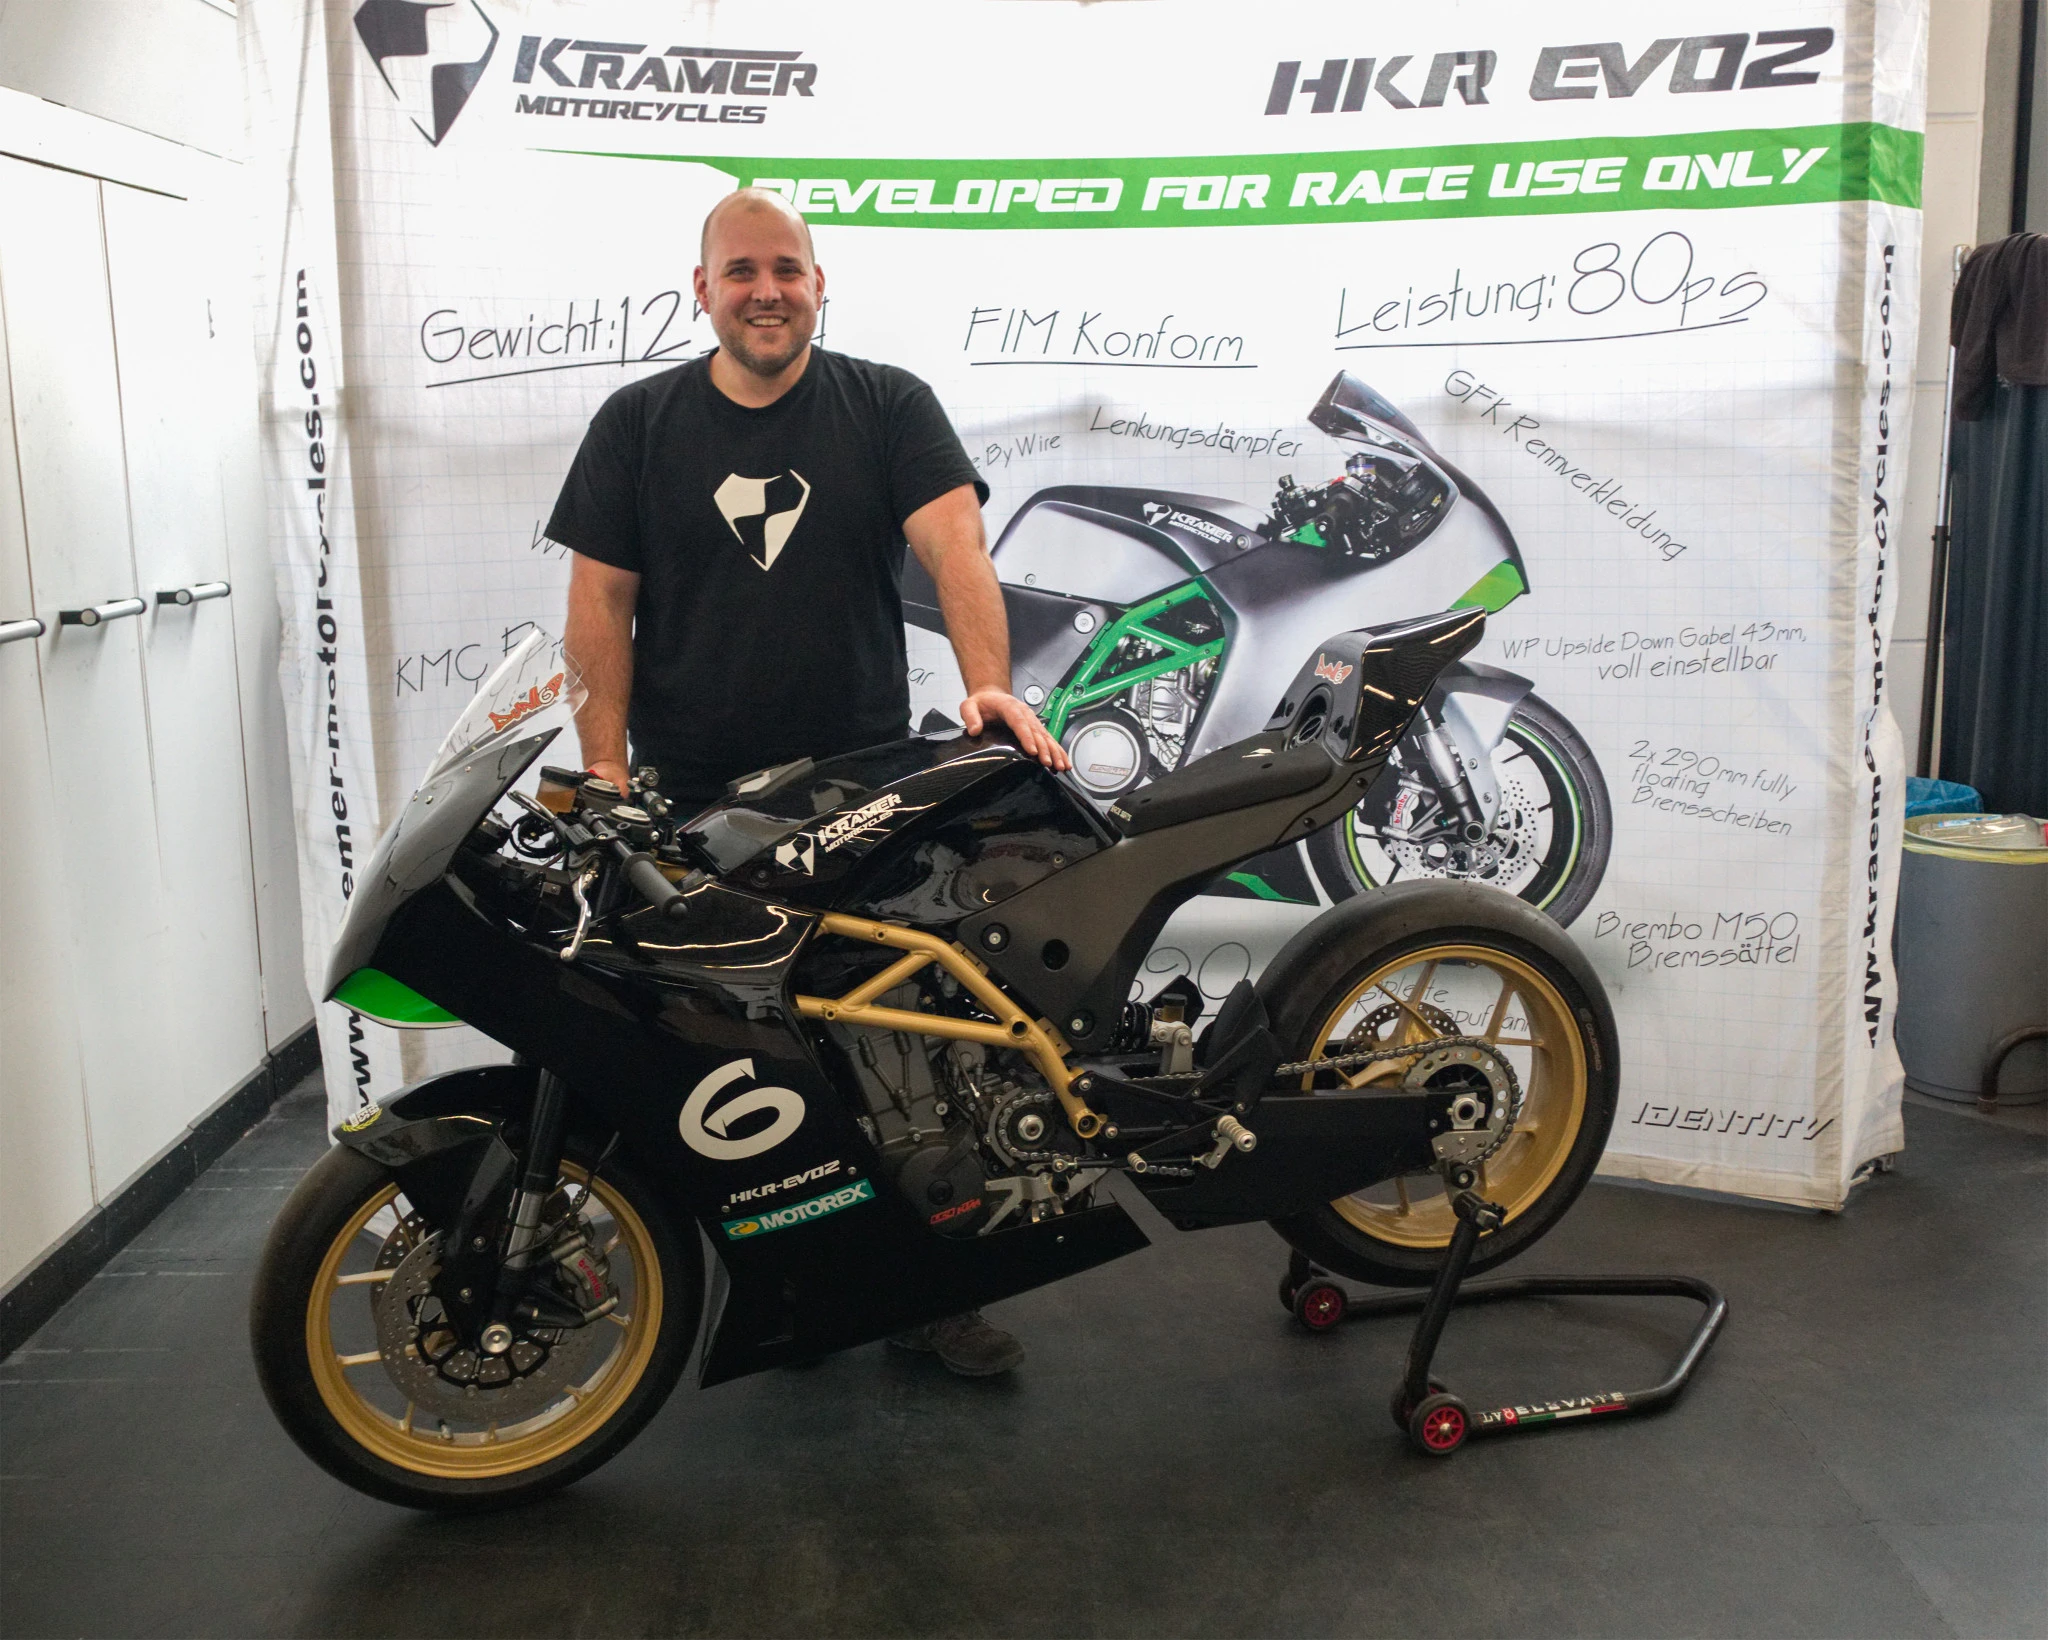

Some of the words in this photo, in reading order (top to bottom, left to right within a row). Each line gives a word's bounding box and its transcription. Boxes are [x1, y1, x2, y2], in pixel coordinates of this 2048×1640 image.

[1264, 50, 1497, 115] HKR
[515, 95, 767, 124] MOTORCYCLES
[1141, 174, 1268, 211] FOR
[1288, 165, 1474, 206] RACE
[1490, 157, 1628, 196] USE
[1641, 147, 1830, 192] ONLY
[964, 307, 1060, 354] FIM
[1073, 311, 1243, 361] Konform
[986, 444, 1013, 468] By
[1016, 433, 1061, 457] Wire
[1090, 406, 1303, 459] Lenkungsdämpfer
[1445, 370, 1511, 426] GFK
[1503, 414, 1687, 562] Rennverkleidung
[1168, 520, 1221, 544] MOTORCYCLES
[1503, 637, 1540, 660] WP
[1545, 634, 1616, 660] Upside
[1621, 631, 1674, 652] Down
[1679, 624, 1735, 648] Gabel
[397, 643, 488, 697] KMC
[1598, 653, 1642, 681] voll
[1650, 646, 1779, 677] einstellbar
[1631, 764, 1711, 799] floating
[1751, 770, 1798, 802] fully
[1632, 786, 1793, 836] Bremsscheiben
[824, 811, 893, 853] MOTORCYCLES
[1594, 911, 1703, 941] Brembo
[1712, 911, 1799, 941] M50
[1627, 934, 1801, 969] Bremssättel
[679, 1057, 806, 1161] 6
[1631, 1102, 1835, 1141] IDENTITY
[759, 1183, 869, 1230] MOTOREX
